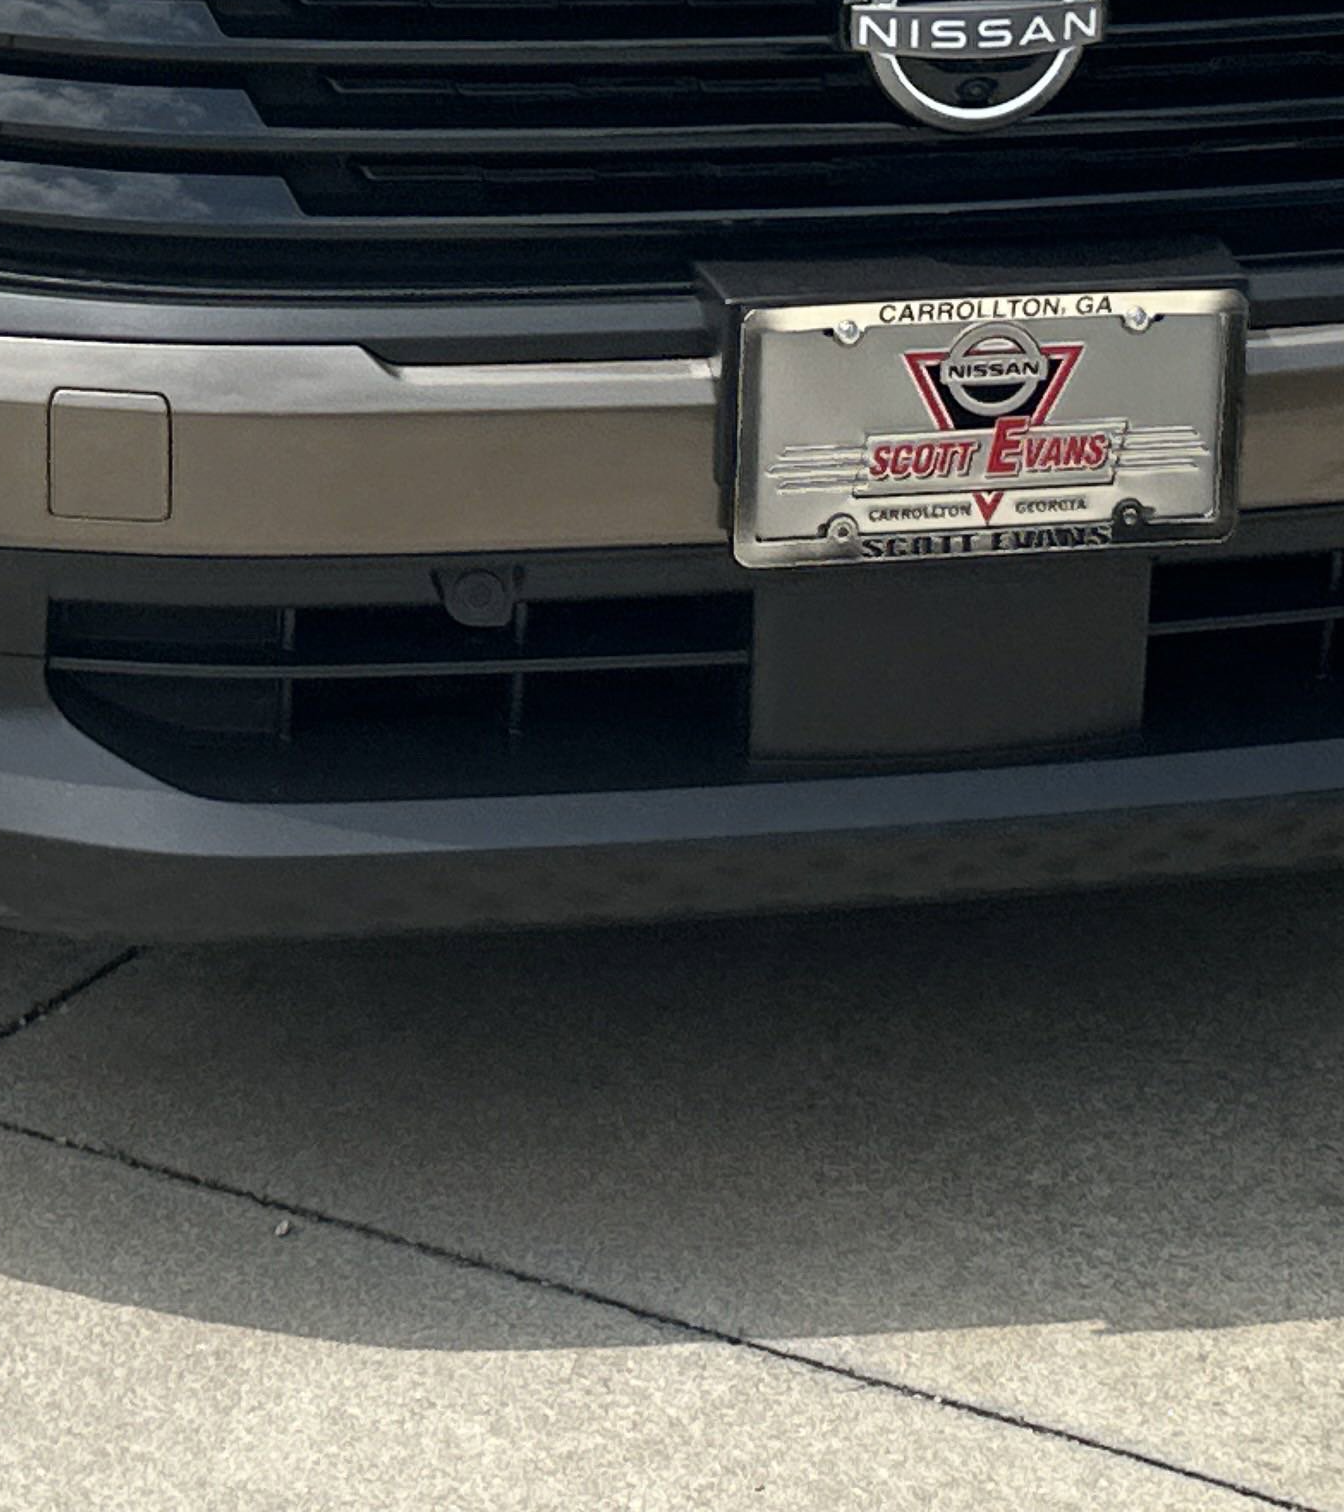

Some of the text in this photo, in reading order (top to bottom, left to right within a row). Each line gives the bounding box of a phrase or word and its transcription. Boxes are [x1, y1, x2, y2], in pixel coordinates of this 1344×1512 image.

[858, 7, 1097, 49] NISSAN
[1075, 295, 1113, 314] GA
[948, 361, 1040, 380] NISSAN
[869, 417, 1109, 477] SCOTT EVANS
[868, 497, 1088, 522] CARROLLTON GEORGIA
